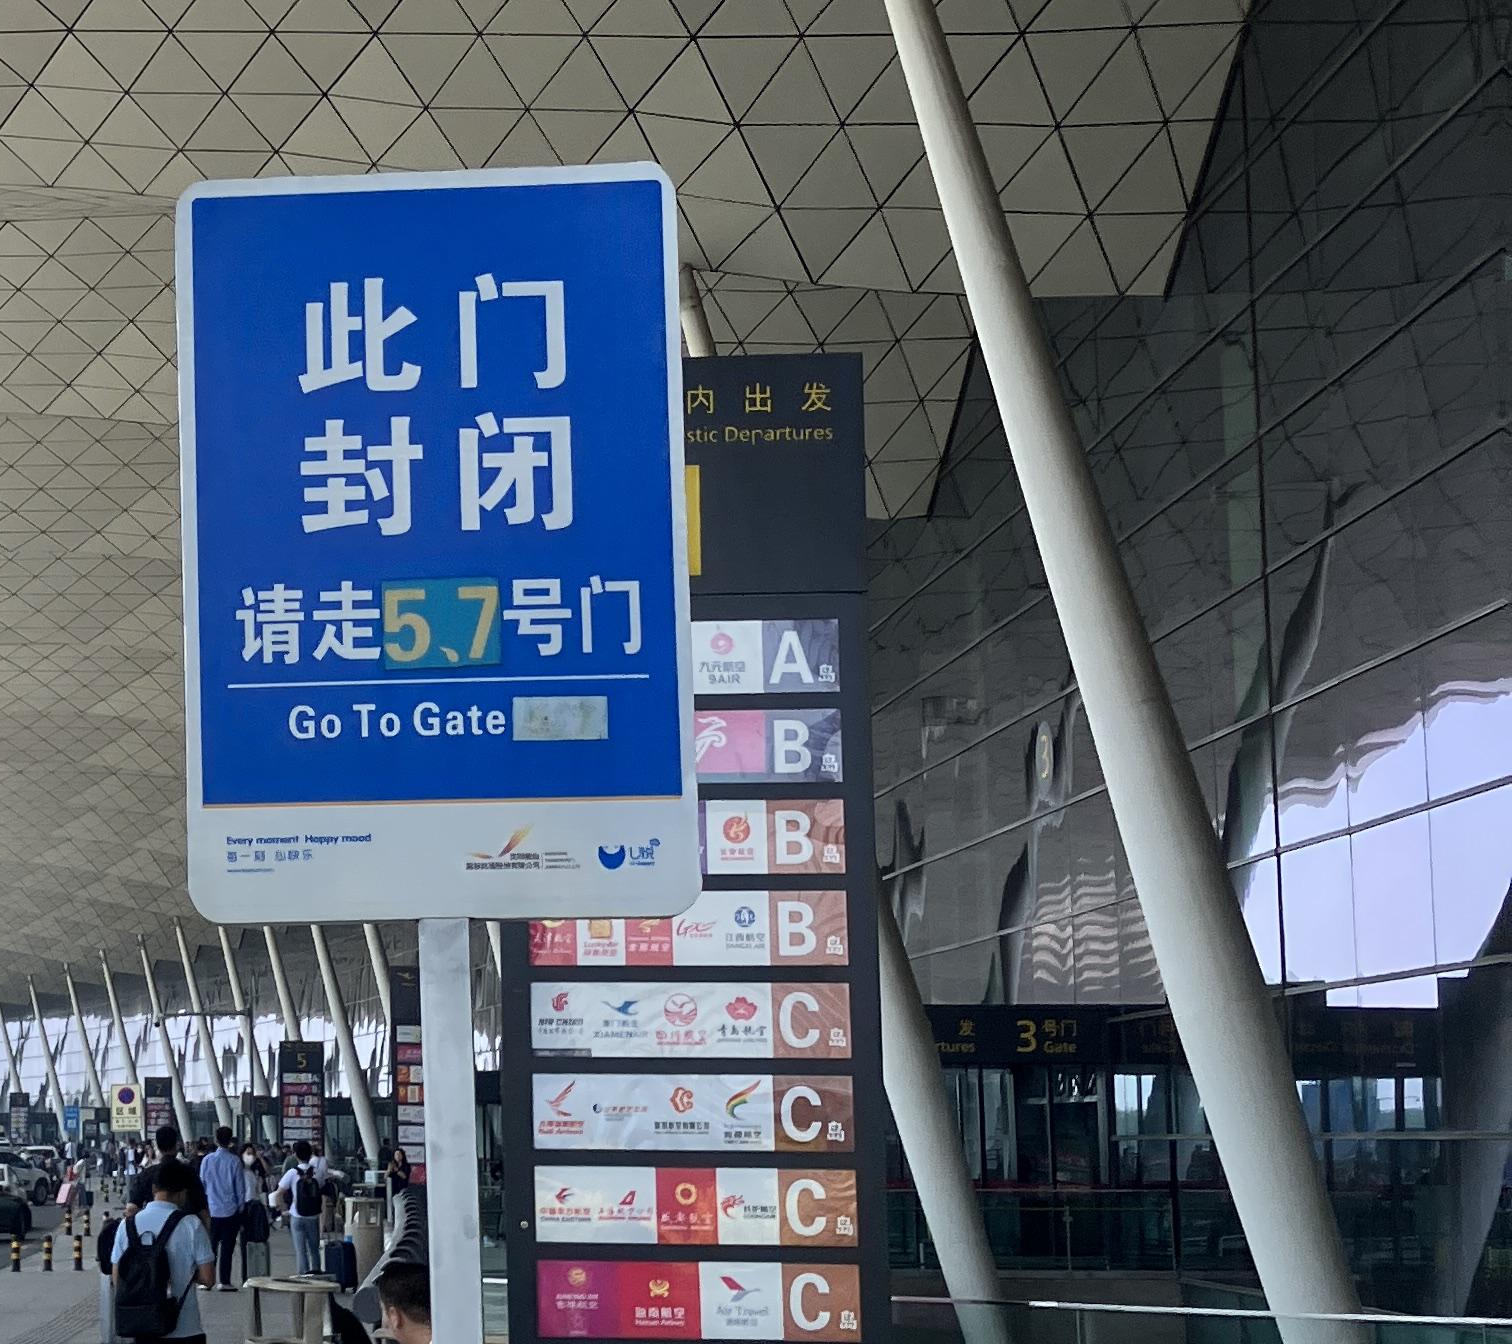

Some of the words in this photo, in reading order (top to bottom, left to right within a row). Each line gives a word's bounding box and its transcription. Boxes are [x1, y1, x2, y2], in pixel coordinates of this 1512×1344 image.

[299, 274, 566, 393] 此门
[687, 382, 832, 414] 内出发
[687, 427, 718, 443] stic
[725, 425, 833, 445] Departures
[301, 412, 572, 535] 封闭
[769, 630, 814, 684] A
[289, 706, 341, 738] Go
[353, 704, 400, 737] To
[414, 702, 505, 735] Gate
[773, 719, 812, 774] B
[226, 836, 253, 847] Every
[256, 835, 299, 845] moment
[304, 834, 339, 846] Happy
[341, 834, 372, 843] mood
[775, 810, 814, 865] B
[777, 901, 817, 956] B
[779, 992, 820, 1049] C
[938, 1042, 976, 1053] rtures
[1016, 1020, 1037, 1053] 3
[1042, 1019, 1077, 1037] 号门
[1044, 1042, 1077, 1053] Gate
[297, 1053, 307, 1068] 5
[780, 1085, 822, 1143] C
[786, 1178, 827, 1237] C
[790, 1272, 831, 1331] C
